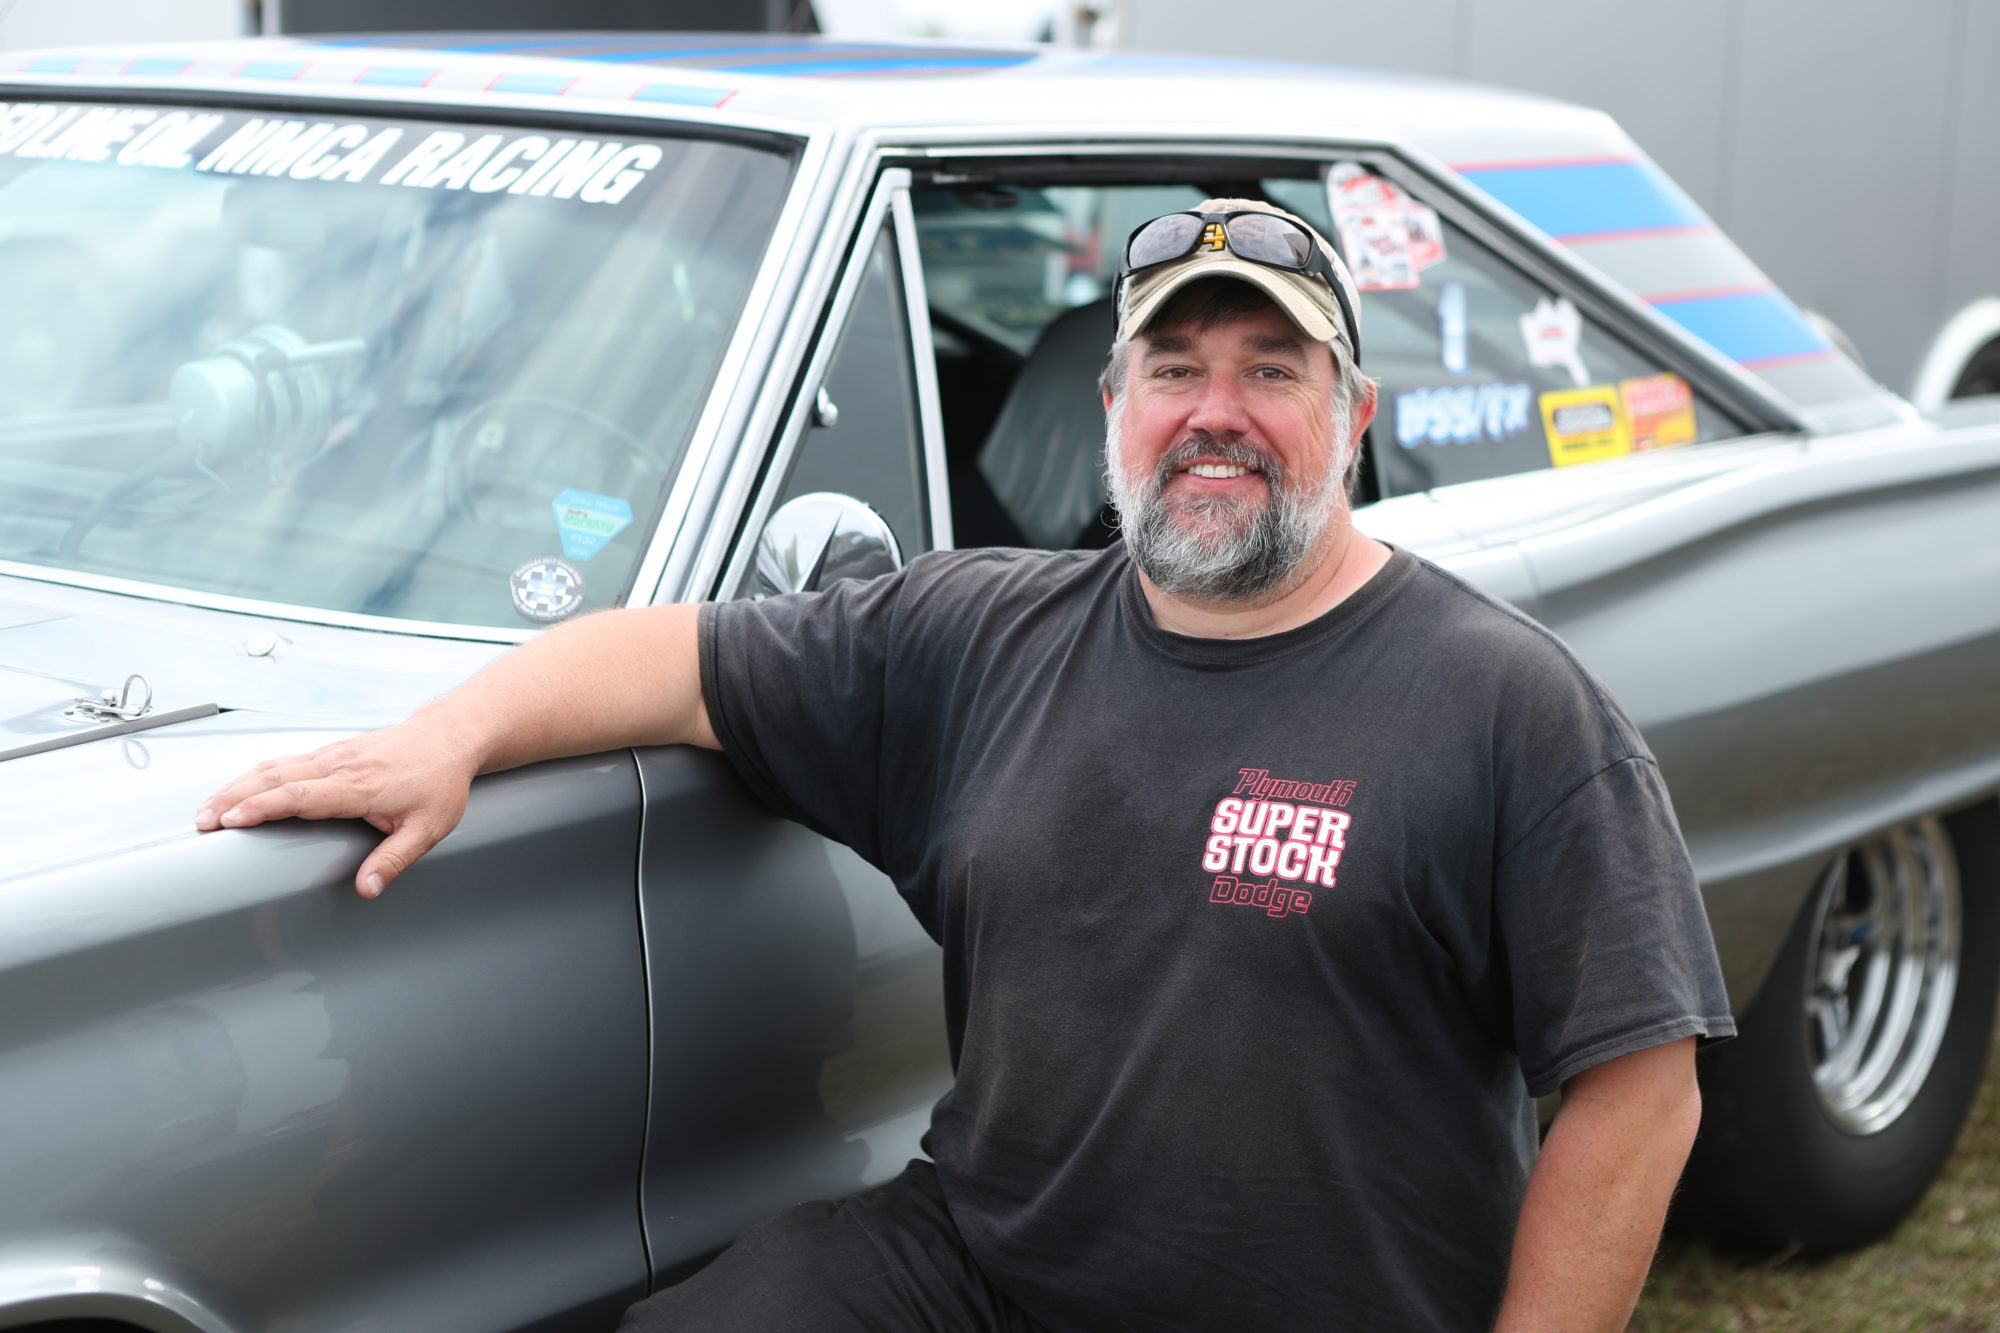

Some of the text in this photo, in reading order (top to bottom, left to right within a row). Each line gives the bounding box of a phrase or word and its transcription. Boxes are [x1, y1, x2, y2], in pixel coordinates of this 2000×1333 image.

[195, 118, 403, 184] NMCA
[380, 130, 663, 205] RACING
[1232, 768, 1357, 807] Plymouth
[1210, 797, 1352, 850] SUPER
[1202, 834, 1341, 888] STOCK
[1209, 875, 1313, 918] Dodge
